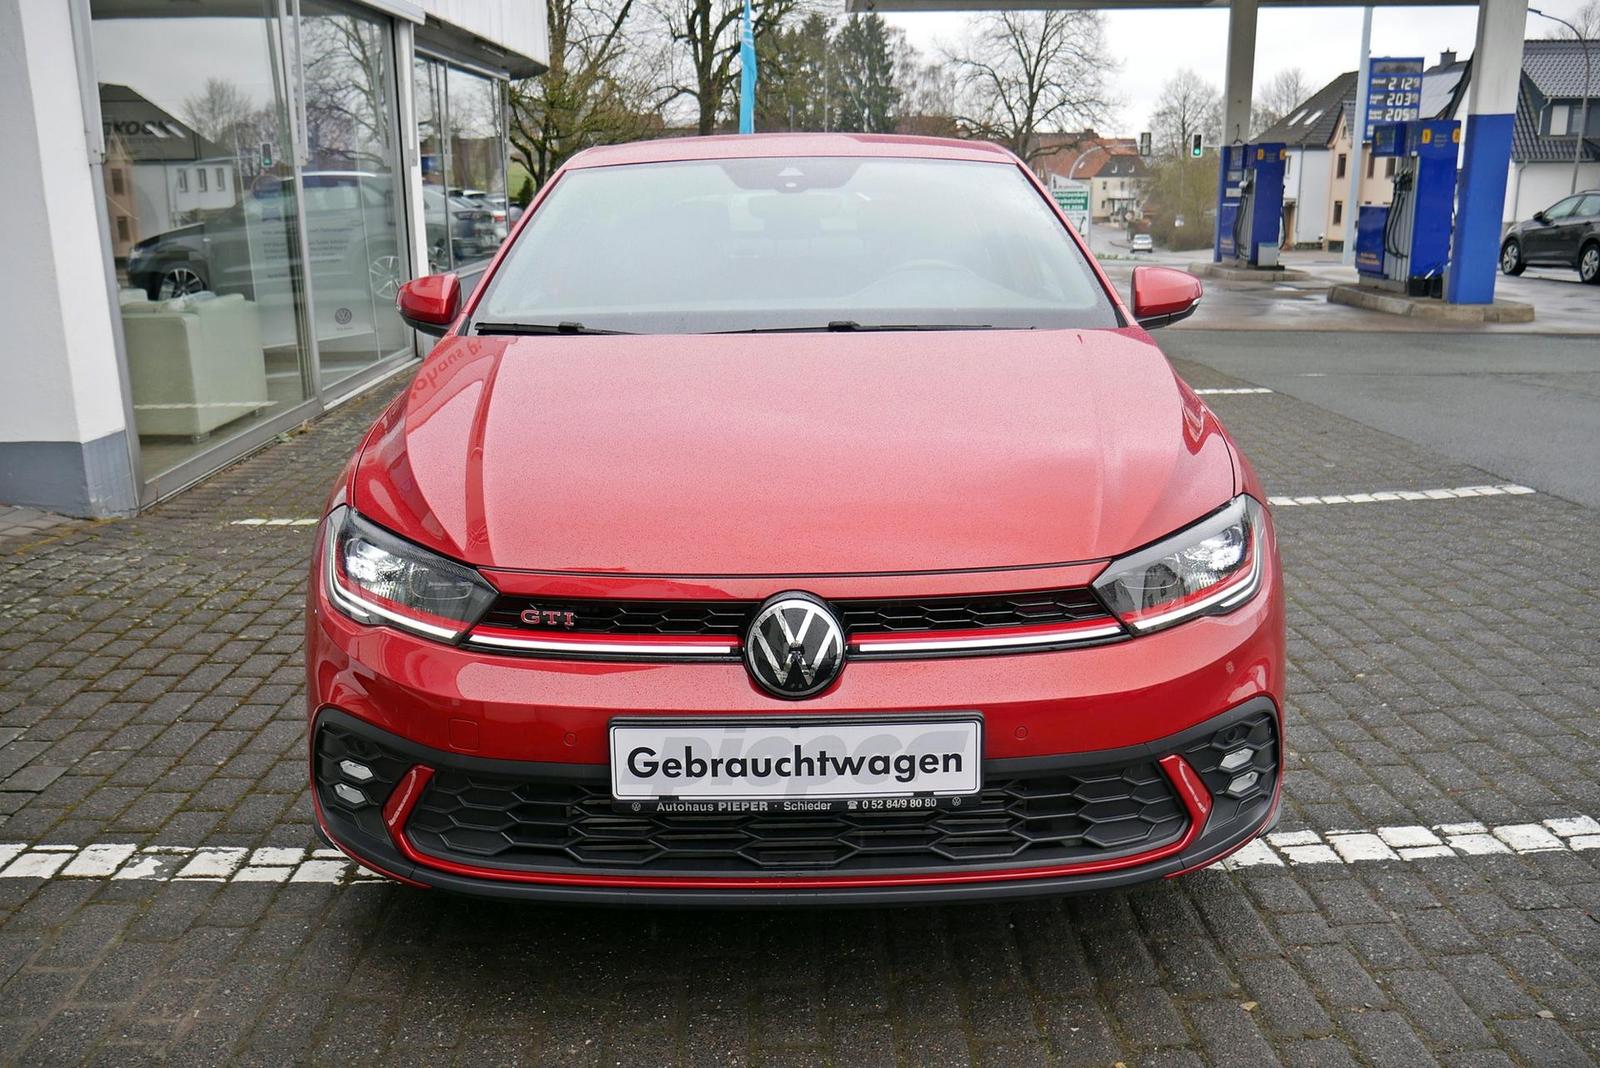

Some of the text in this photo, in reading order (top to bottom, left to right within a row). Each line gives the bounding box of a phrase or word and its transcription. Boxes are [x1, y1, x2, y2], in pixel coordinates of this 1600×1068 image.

[520, 609, 575, 626] GTI
[627, 744, 963, 783] Gebrauchtwagen
[656, 801, 714, 812] Autohaus
[718, 801, 768, 811] PIEPER
[783, 801, 832, 811] Schieder
[871, 800, 883, 809] 52
[886, 799, 907, 808] 84/9
[909, 799, 922, 808] 80
[924, 798, 937, 807] 80
